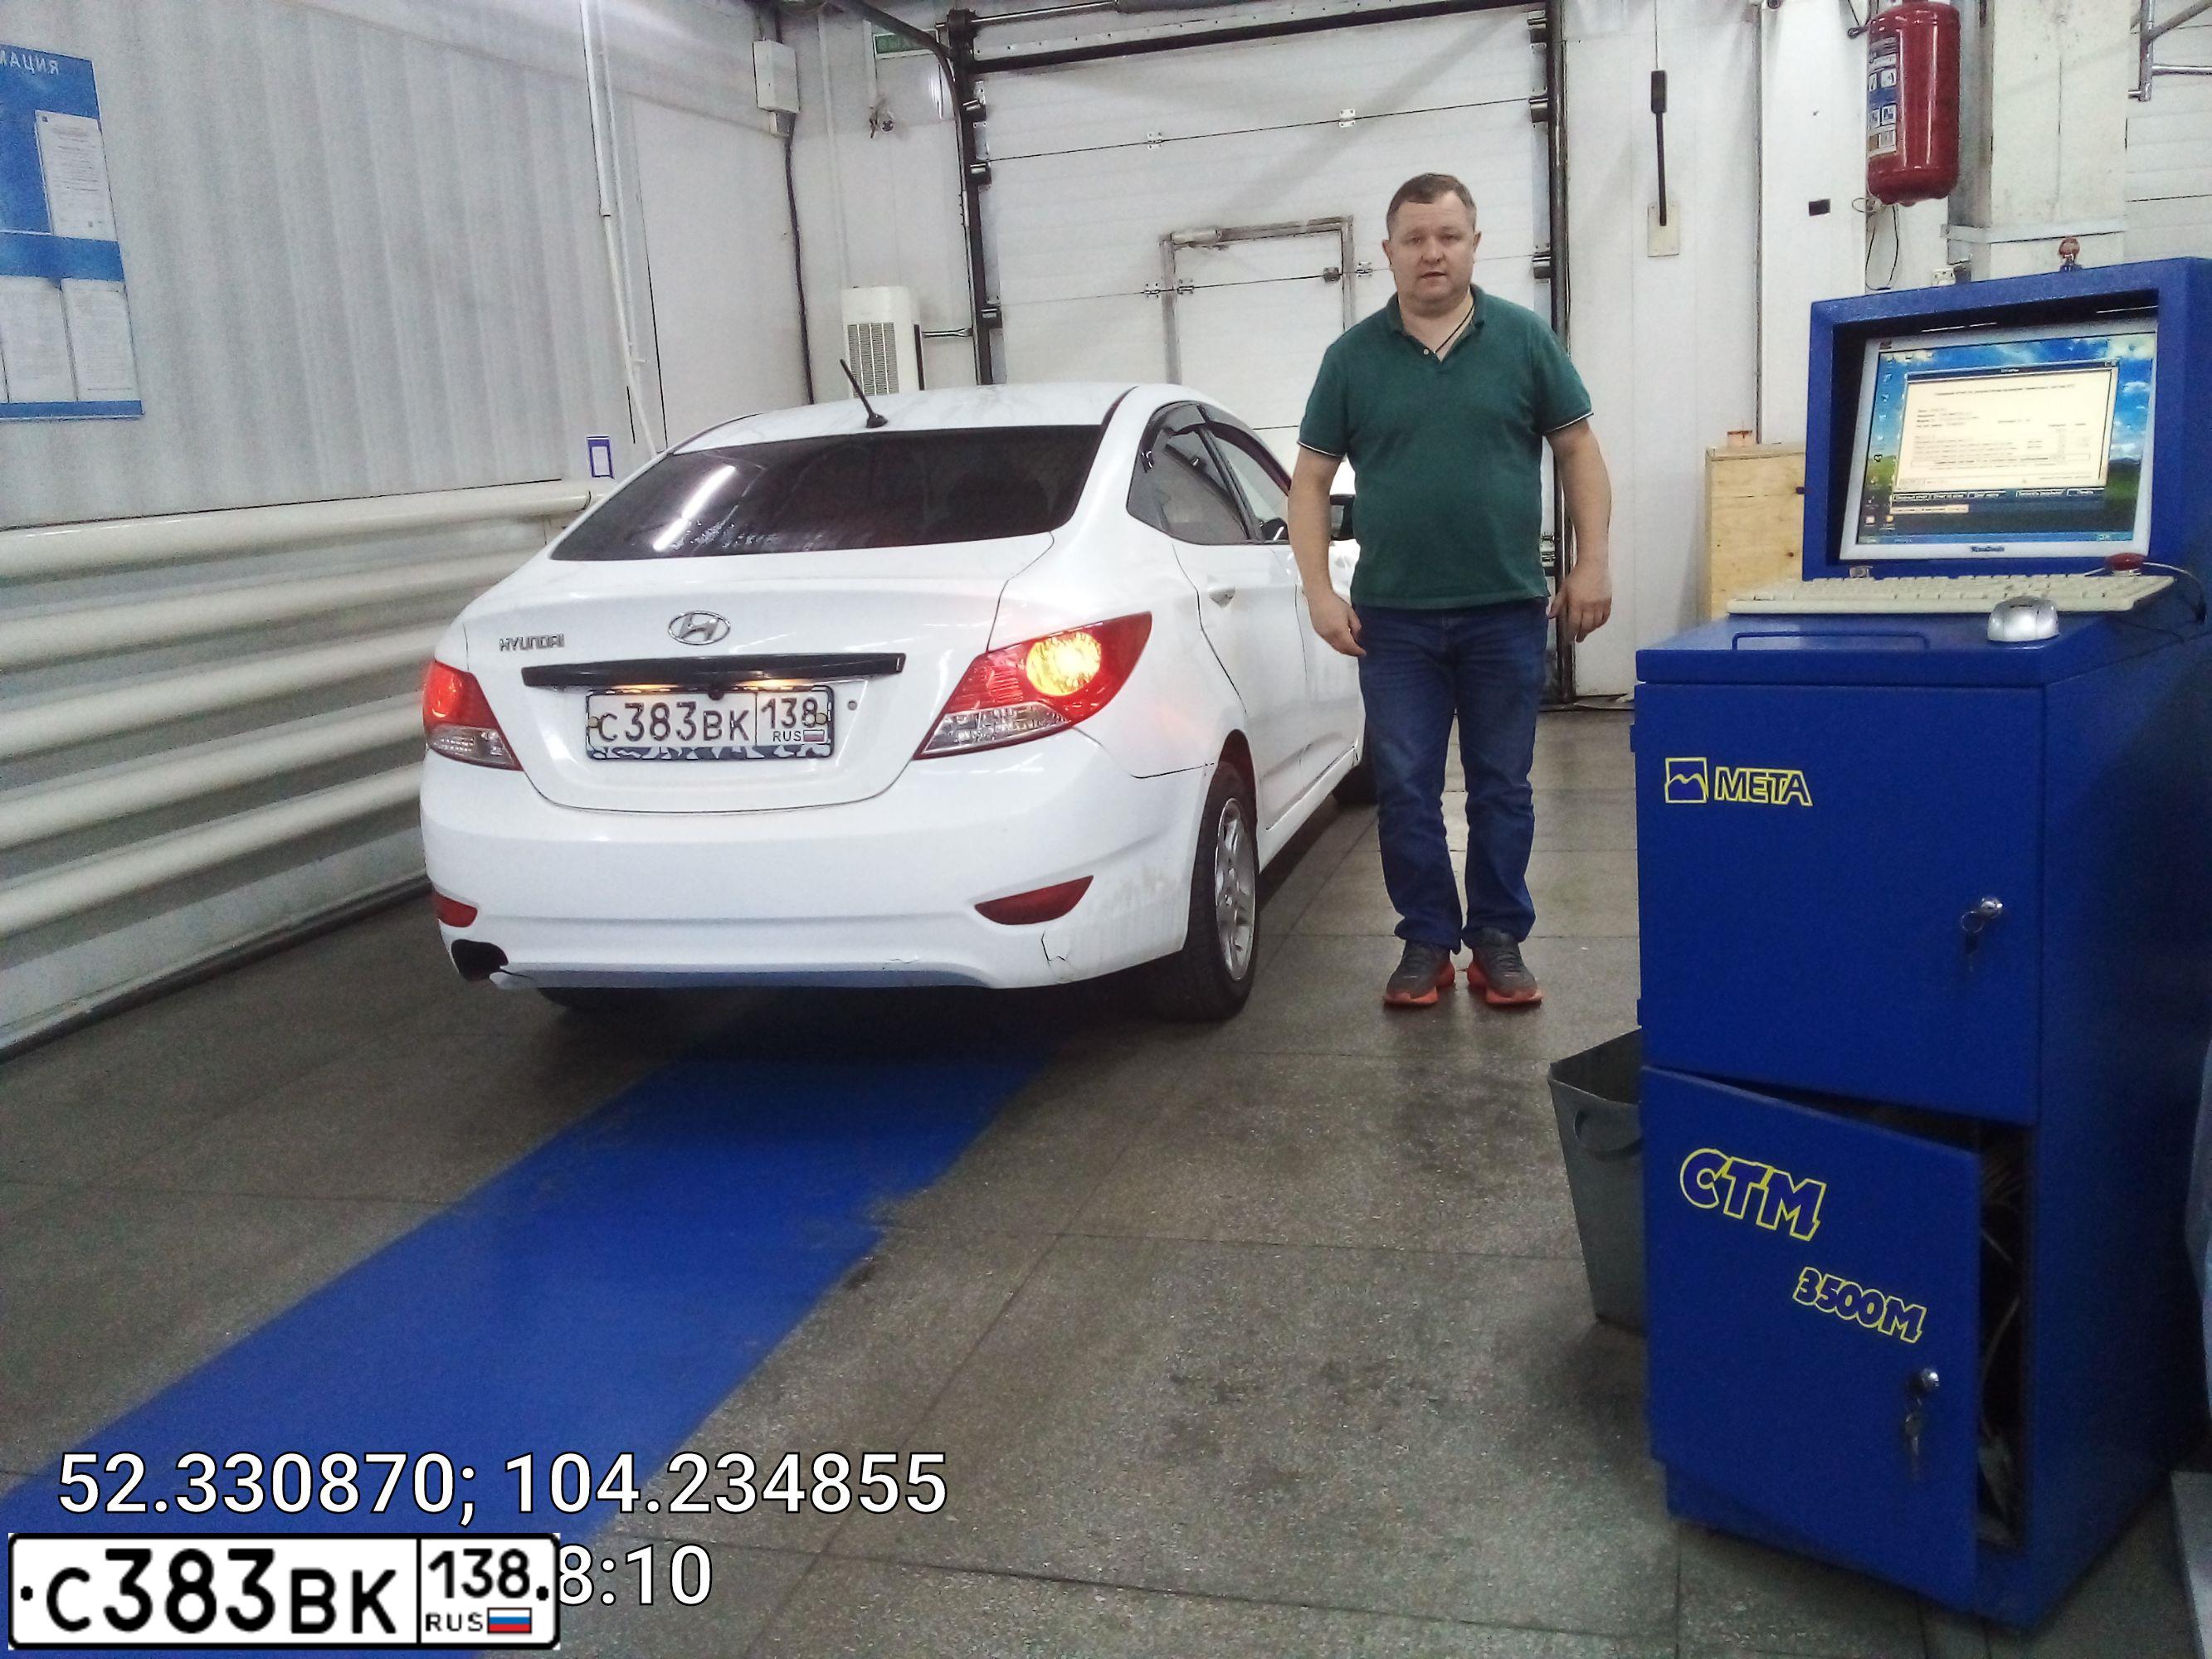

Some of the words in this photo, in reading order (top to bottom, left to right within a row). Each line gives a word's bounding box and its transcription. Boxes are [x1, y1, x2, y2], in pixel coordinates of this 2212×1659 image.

[499, 634, 565, 651] HYUNDAI
[762, 697, 819, 728] 138
[772, 730, 801, 742] RUS
